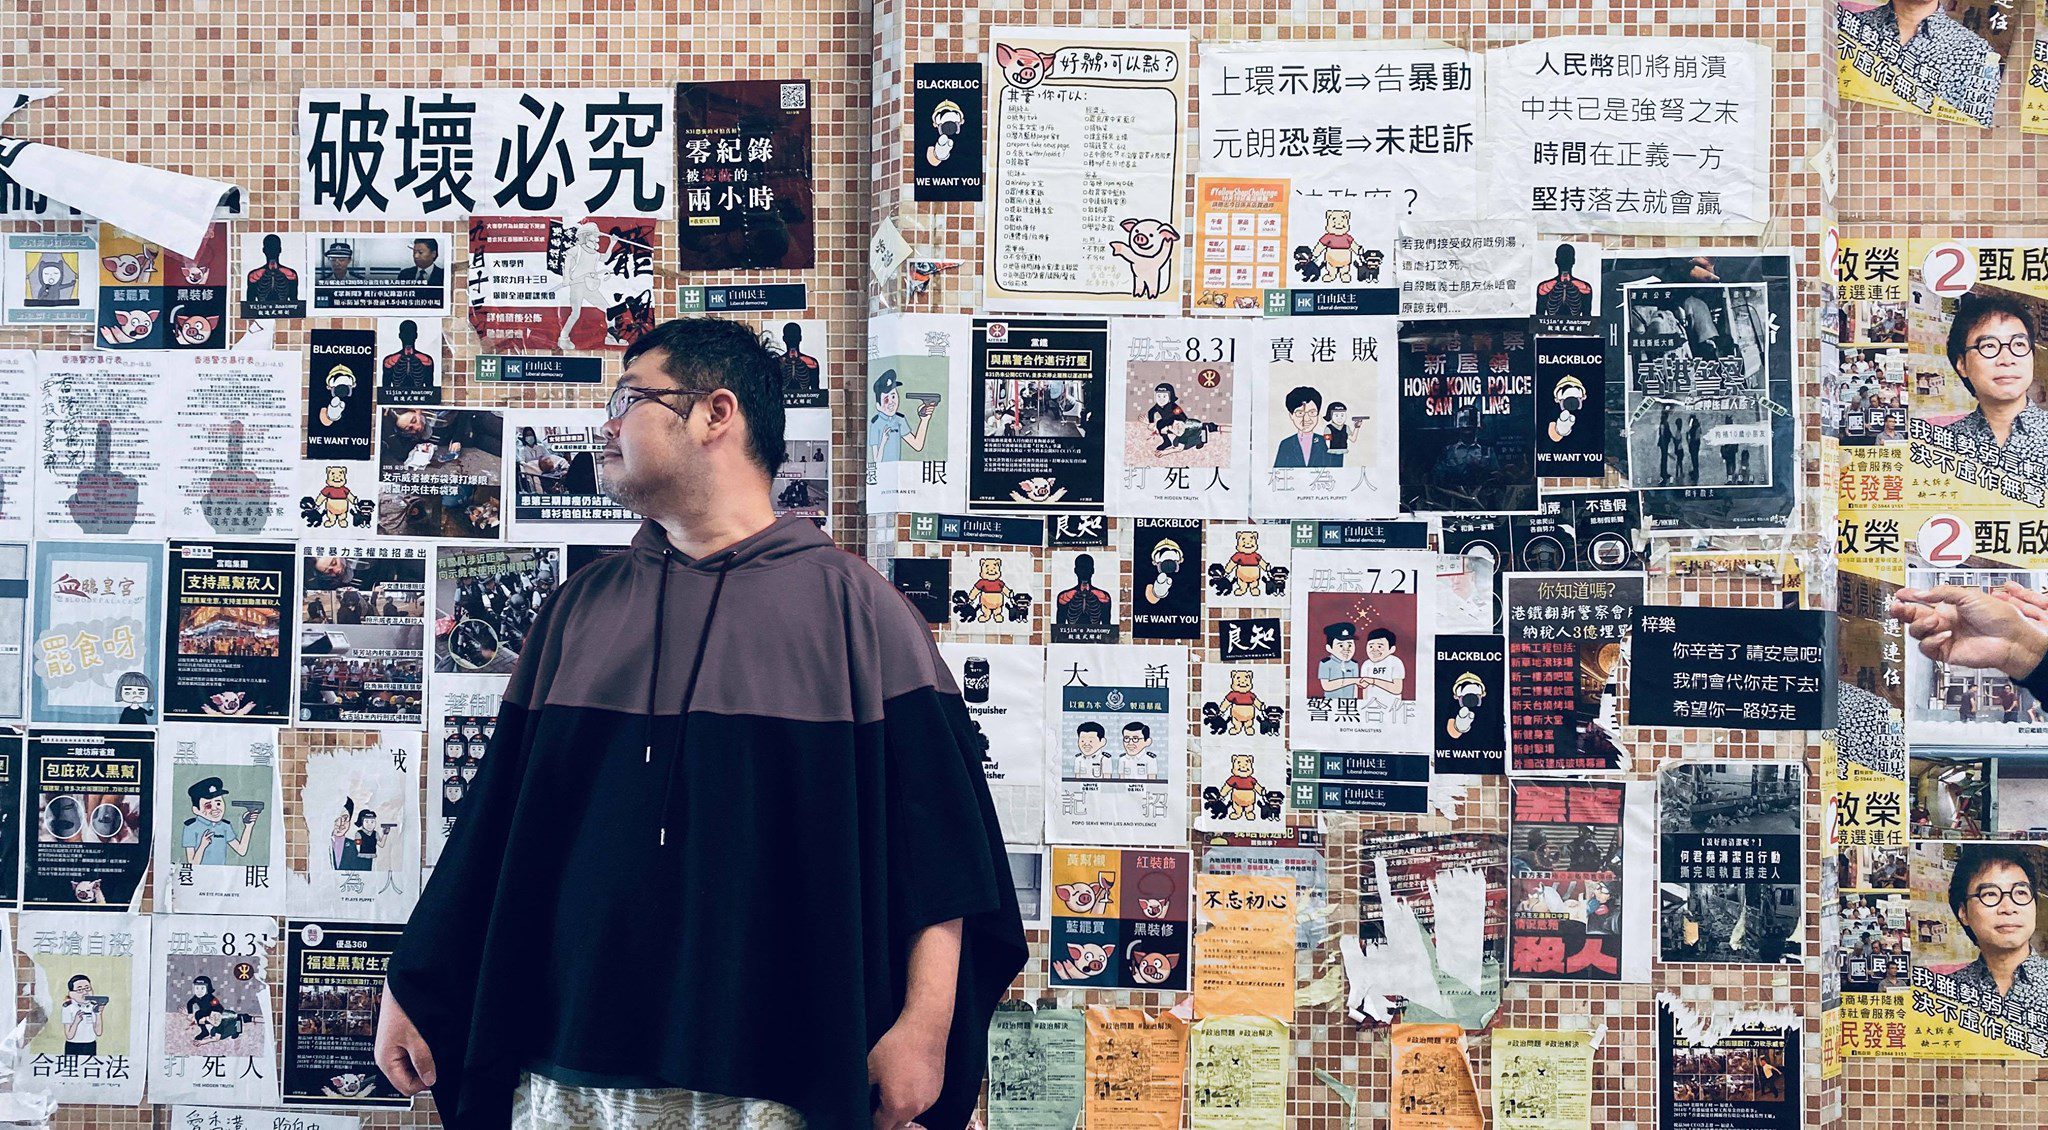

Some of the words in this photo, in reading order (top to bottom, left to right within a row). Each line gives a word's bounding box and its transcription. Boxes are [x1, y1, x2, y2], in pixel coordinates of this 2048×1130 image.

[1837, 5, 1941, 89] 雖勢弱言輕
[1535, 52, 1727, 79] 人民幣即將崩潰
[916, 79, 980, 90] BLACKBLOC
[1212, 63, 1342, 97] 上環示威
[1374, 61, 1472, 92] 告暴動
[1213, 126, 1343, 159] 元朗恐襲
[1375, 122, 1474, 155] 未起訴
[307, 91, 666, 214] 破壞必究
[685, 137, 774, 164] 零紀錄
[1533, 140, 1725, 170] 時間在正義一方
[916, 177, 931, 186] WE
[932, 177, 960, 186] WANT
[961, 177, 981, 186] YOU
[687, 185, 775, 212] 兩小時
[1531, 186, 1723, 216] 堅持落去就會贏
[492, 260, 524, 268] 大專學界
[1934, 247, 1969, 292] 2
[492, 275, 548, 285] 將於九月十三日
[112, 288, 151, 302] 藍罷買
[176, 288, 215, 302] 黑裝修
[711, 295, 724, 304] HK
[728, 289, 767, 300] 自由民主
[1317, 293, 1357, 304] 自由民主
[1297, 297, 1312, 307] HK
[313, 344, 373, 355] BLACKBLOC
[1268, 336, 1379, 364] 賣港賊
[525, 361, 563, 371] 自由民主
[990, 354, 1088, 367] 與黑警合作進行打壓
[1424, 353, 1511, 375] 新屋嶺
[1538, 354, 1603, 365] BLACKBLOC
[507, 364, 520, 373] HK
[1637, 355, 1746, 398] 香港警察
[1404, 377, 1440, 397] HONG
[1447, 377, 1482, 396] KONG
[1488, 376, 1532, 395] POLICE
[1425, 397, 1452, 416] SAN
[1482, 397, 1511, 415] LING
[308, 436, 323, 446] WE
[323, 436, 350, 446] WANT
[350, 436, 370, 446] YOU
[1537, 453, 1552, 462] WE
[1553, 453, 1582, 462] WANT
[1583, 453, 1603, 462] YOU
[1909, 417, 2047, 484] 我雖勢弱言輕
[382, 472, 489, 485] 女示威者被布袋彈打爆眼
[1123, 463, 1231, 492] 打死人
[1909, 442, 2046, 509] 決不虛作無聲
[1917, 490, 1959, 499] 缺一不可
[1585, 499, 1628, 513] 不造假
[944, 523, 958, 533] HK
[963, 520, 1003, 531] 自由民主
[1136, 518, 1200, 529] BLACKBLOC
[1324, 530, 1339, 539] HK
[1344, 526, 1385, 536] 自由民主
[1929, 517, 1963, 562] 2
[303, 546, 427, 558] 瘋警暴力濫權陰招盡出
[52, 573, 135, 600] 血臨皇宮
[187, 574, 276, 591] 支持黑幫砍人
[1537, 582, 1616, 600] 你知道嗎?
[1134, 614, 1149, 624] WE
[1150, 614, 1178, 624] WANT
[1179, 614, 1199, 624] YOU
[1641, 616, 1676, 634] 梓樂
[1226, 622, 1276, 654] 良知
[41, 626, 137, 677] 罷食呀
[1437, 651, 1503, 662] BLACKBLOC
[1672, 642, 1742, 661] 你辛苦了
[1746, 645, 1823, 663] 請安息吧!
[1372, 667, 1387, 675] BFF
[1673, 672, 1820, 693] 我們會代你走下去!
[966, 705, 1008, 716] tinguisher
[1306, 696, 1417, 724] 警黑合作
[1673, 700, 1797, 721] 希望你一路好走
[1512, 715, 1564, 726] 新會所大堂
[1512, 729, 1555, 740] 新健身室
[1436, 749, 1451, 760] WE
[1452, 749, 1480, 760] WANT
[1480, 749, 1503, 760] YOU
[1326, 761, 1341, 771] HK
[1346, 757, 1386, 769] 自由民主
[46, 763, 136, 779] 包庇砍人黑幫
[1324, 791, 1339, 801] HK
[1344, 788, 1385, 799] 自由民主
[1066, 853, 1106, 867] 黃幫襯
[1136, 855, 1177, 870] 紅裝飾
[1680, 850, 1781, 864] 何君堯清潔日行動
[1679, 866, 1781, 880] 撕完唔執直接走人
[1204, 890, 1287, 910] 不忘初心
[1065, 919, 1105, 935] 藍罷買
[1134, 922, 1174, 937] 黑裝修
[32, 930, 134, 957] 吞槍自殺
[335, 939, 368, 949] 優品360
[1912, 965, 2048, 1033] 我雖勢弱言輕
[997, 1021, 1031, 1030] #政治問題
[1034, 1021, 1069, 1031] #政治解決
[1100, 1021, 1135, 1030] #政治問題
[1138, 1021, 1173, 1031] #政治解決
[1912, 989, 2048, 1059] 決不虛作無聲
[1914, 1026, 1955, 1035] 五大訴求
[1201, 1028, 1236, 1037] #政治問題
[1239, 1028, 1274, 1038] #政治解決
[1840, 1021, 1907, 1050] 民發聲
[1406, 1036, 1442, 1045] #政治問題
[1507, 1039, 1542, 1048] #政治問題
[1544, 1039, 1580, 1049] #政治解決
[1920, 1039, 1963, 1049] 缺一不可
[29, 1052, 130, 1080] 合理合法
[164, 1054, 264, 1080] 打死人
